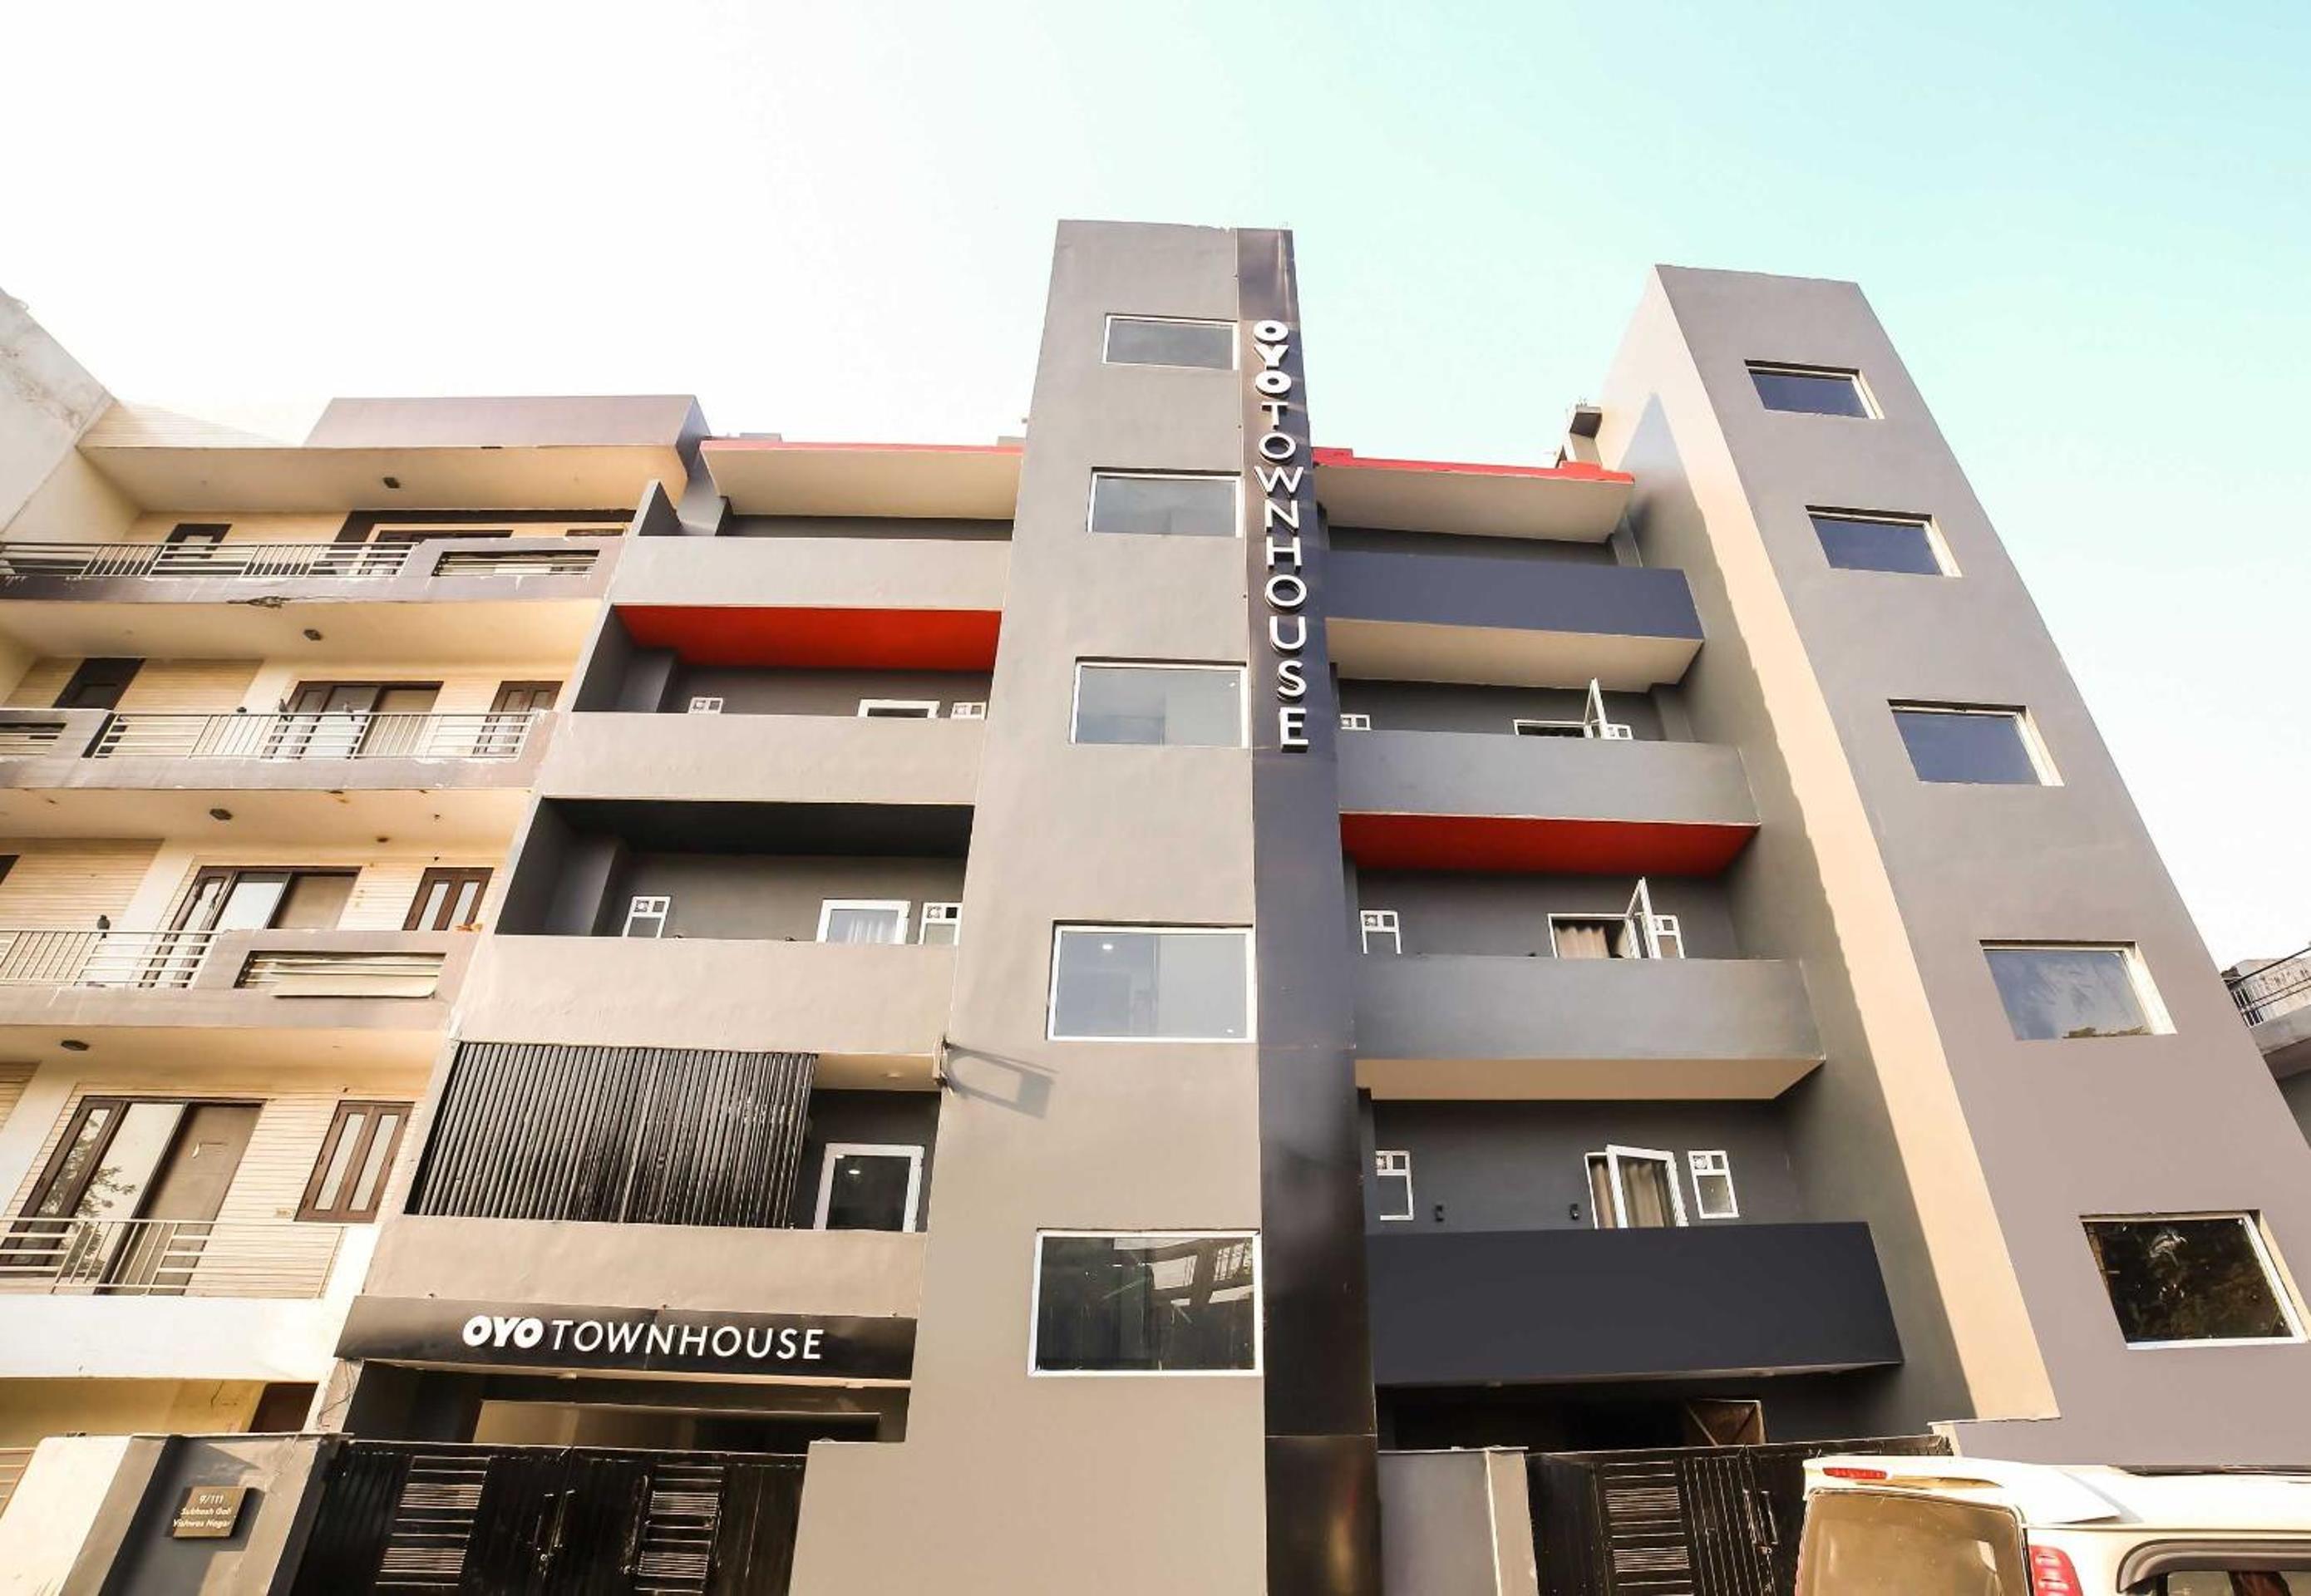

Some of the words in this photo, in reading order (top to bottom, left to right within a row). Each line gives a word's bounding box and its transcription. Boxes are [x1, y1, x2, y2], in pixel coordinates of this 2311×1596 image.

[1254, 319, 1292, 397] OYO
[1254, 401, 1309, 752] TOWNHOUSE
[462, 1315, 545, 1348] OYO
[550, 1319, 824, 1360] TOWNHOUSE
[199, 1495, 224, 1505] 9/111
[205, 1519, 232, 1530] Nagar
